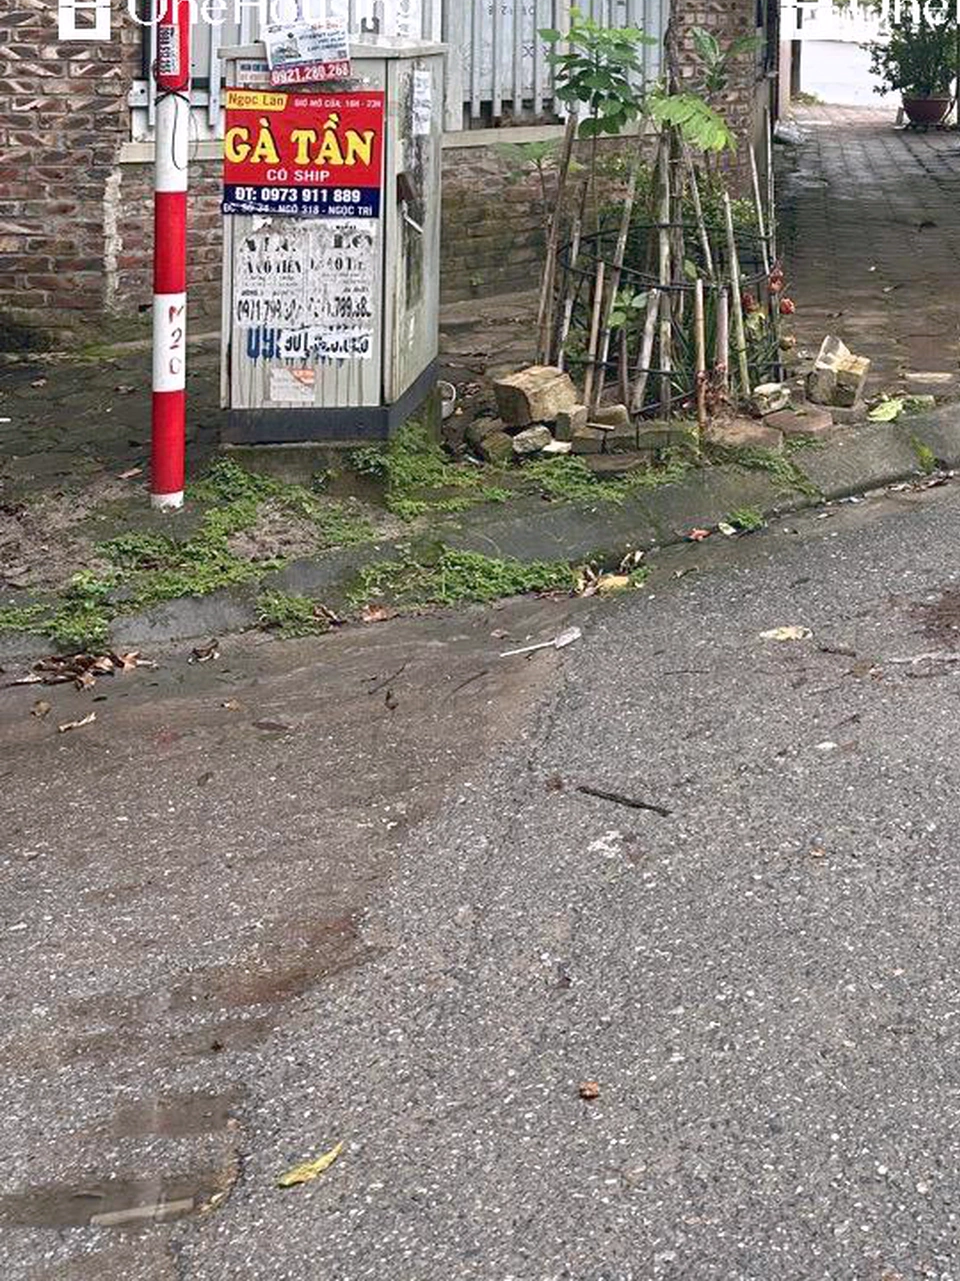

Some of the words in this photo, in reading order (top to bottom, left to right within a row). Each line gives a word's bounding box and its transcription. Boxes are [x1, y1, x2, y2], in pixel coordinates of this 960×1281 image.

[262, 94, 284, 106] Lan
[225, 116, 281, 163] GÀ
[290, 112, 375, 166] TẦN
[266, 167, 288, 181] CÓ
[294, 169, 330, 182] SHIP
[261, 187, 298, 202] 0973
[302, 188, 328, 202] 911
[333, 189, 361, 203] 889
